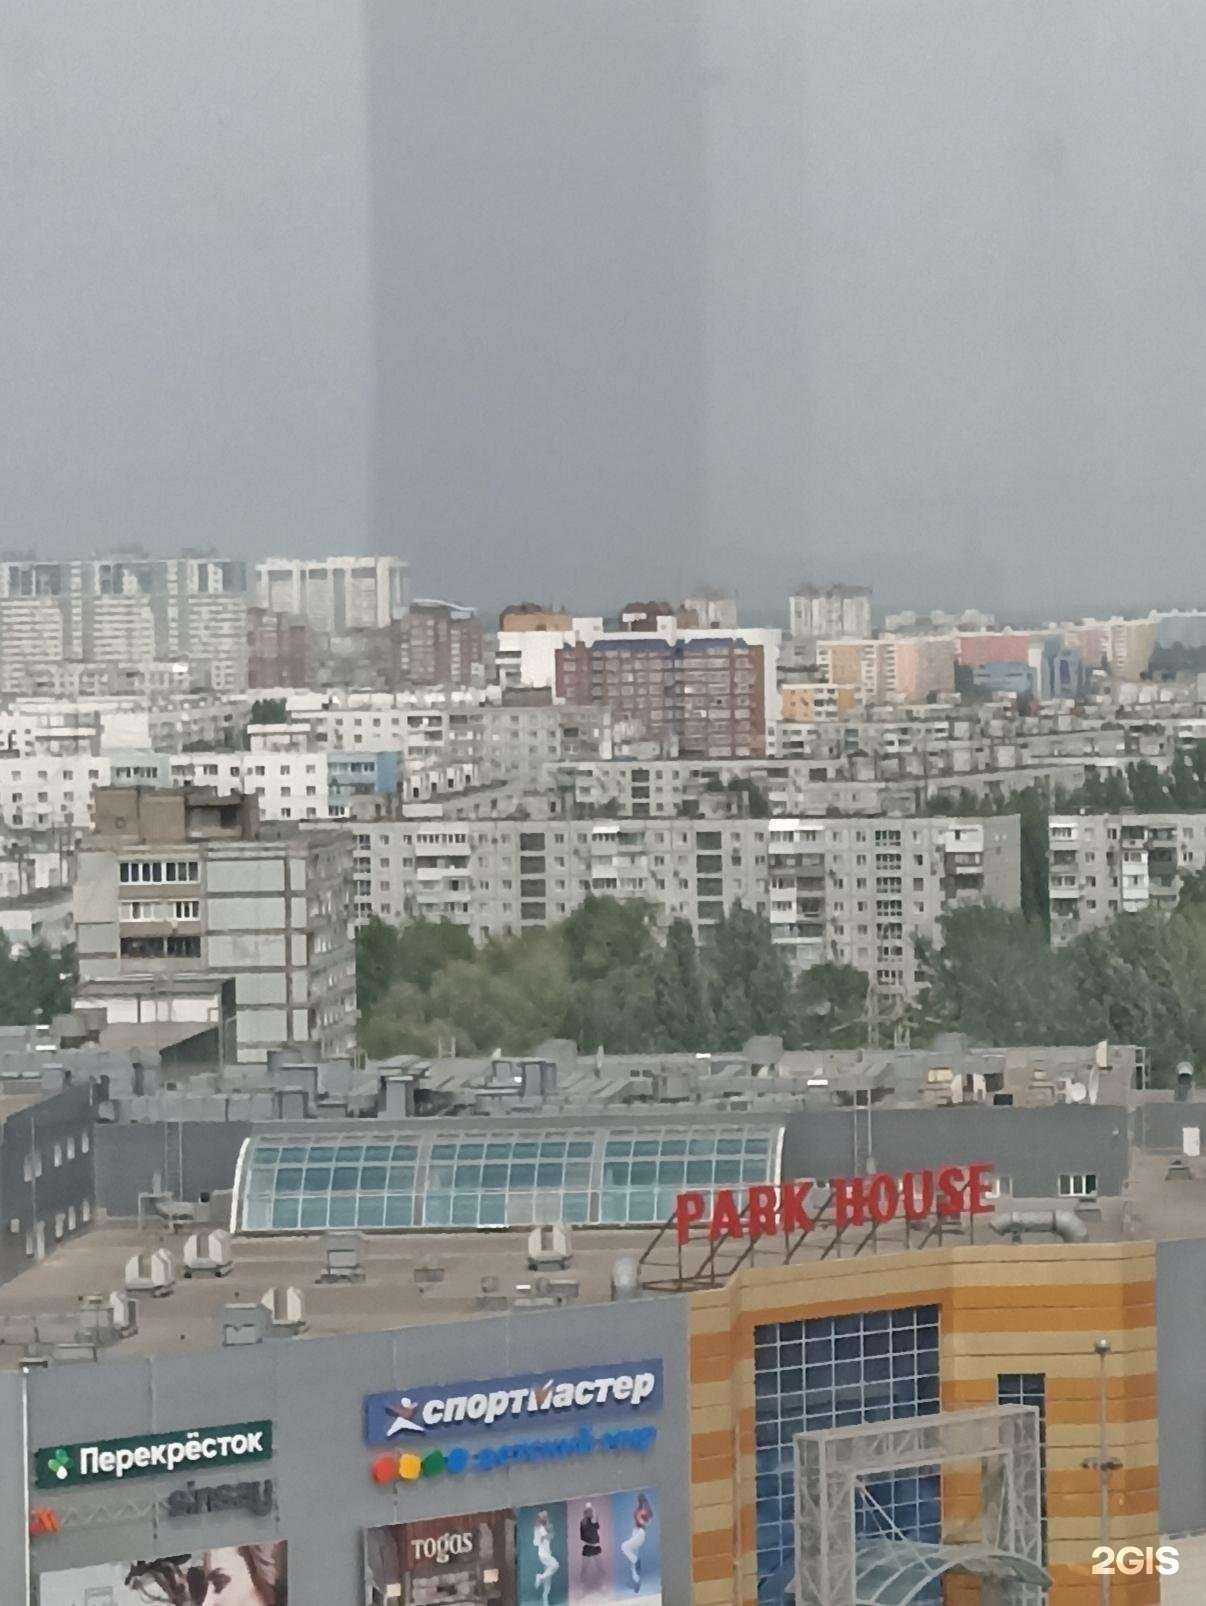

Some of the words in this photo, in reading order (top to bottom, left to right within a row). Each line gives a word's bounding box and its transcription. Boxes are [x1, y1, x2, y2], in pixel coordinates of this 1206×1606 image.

[677, 1180, 816, 1245] PARK
[834, 1162, 995, 1226] HOUSE
[80, 1432, 263, 1478] Перекрёсток
